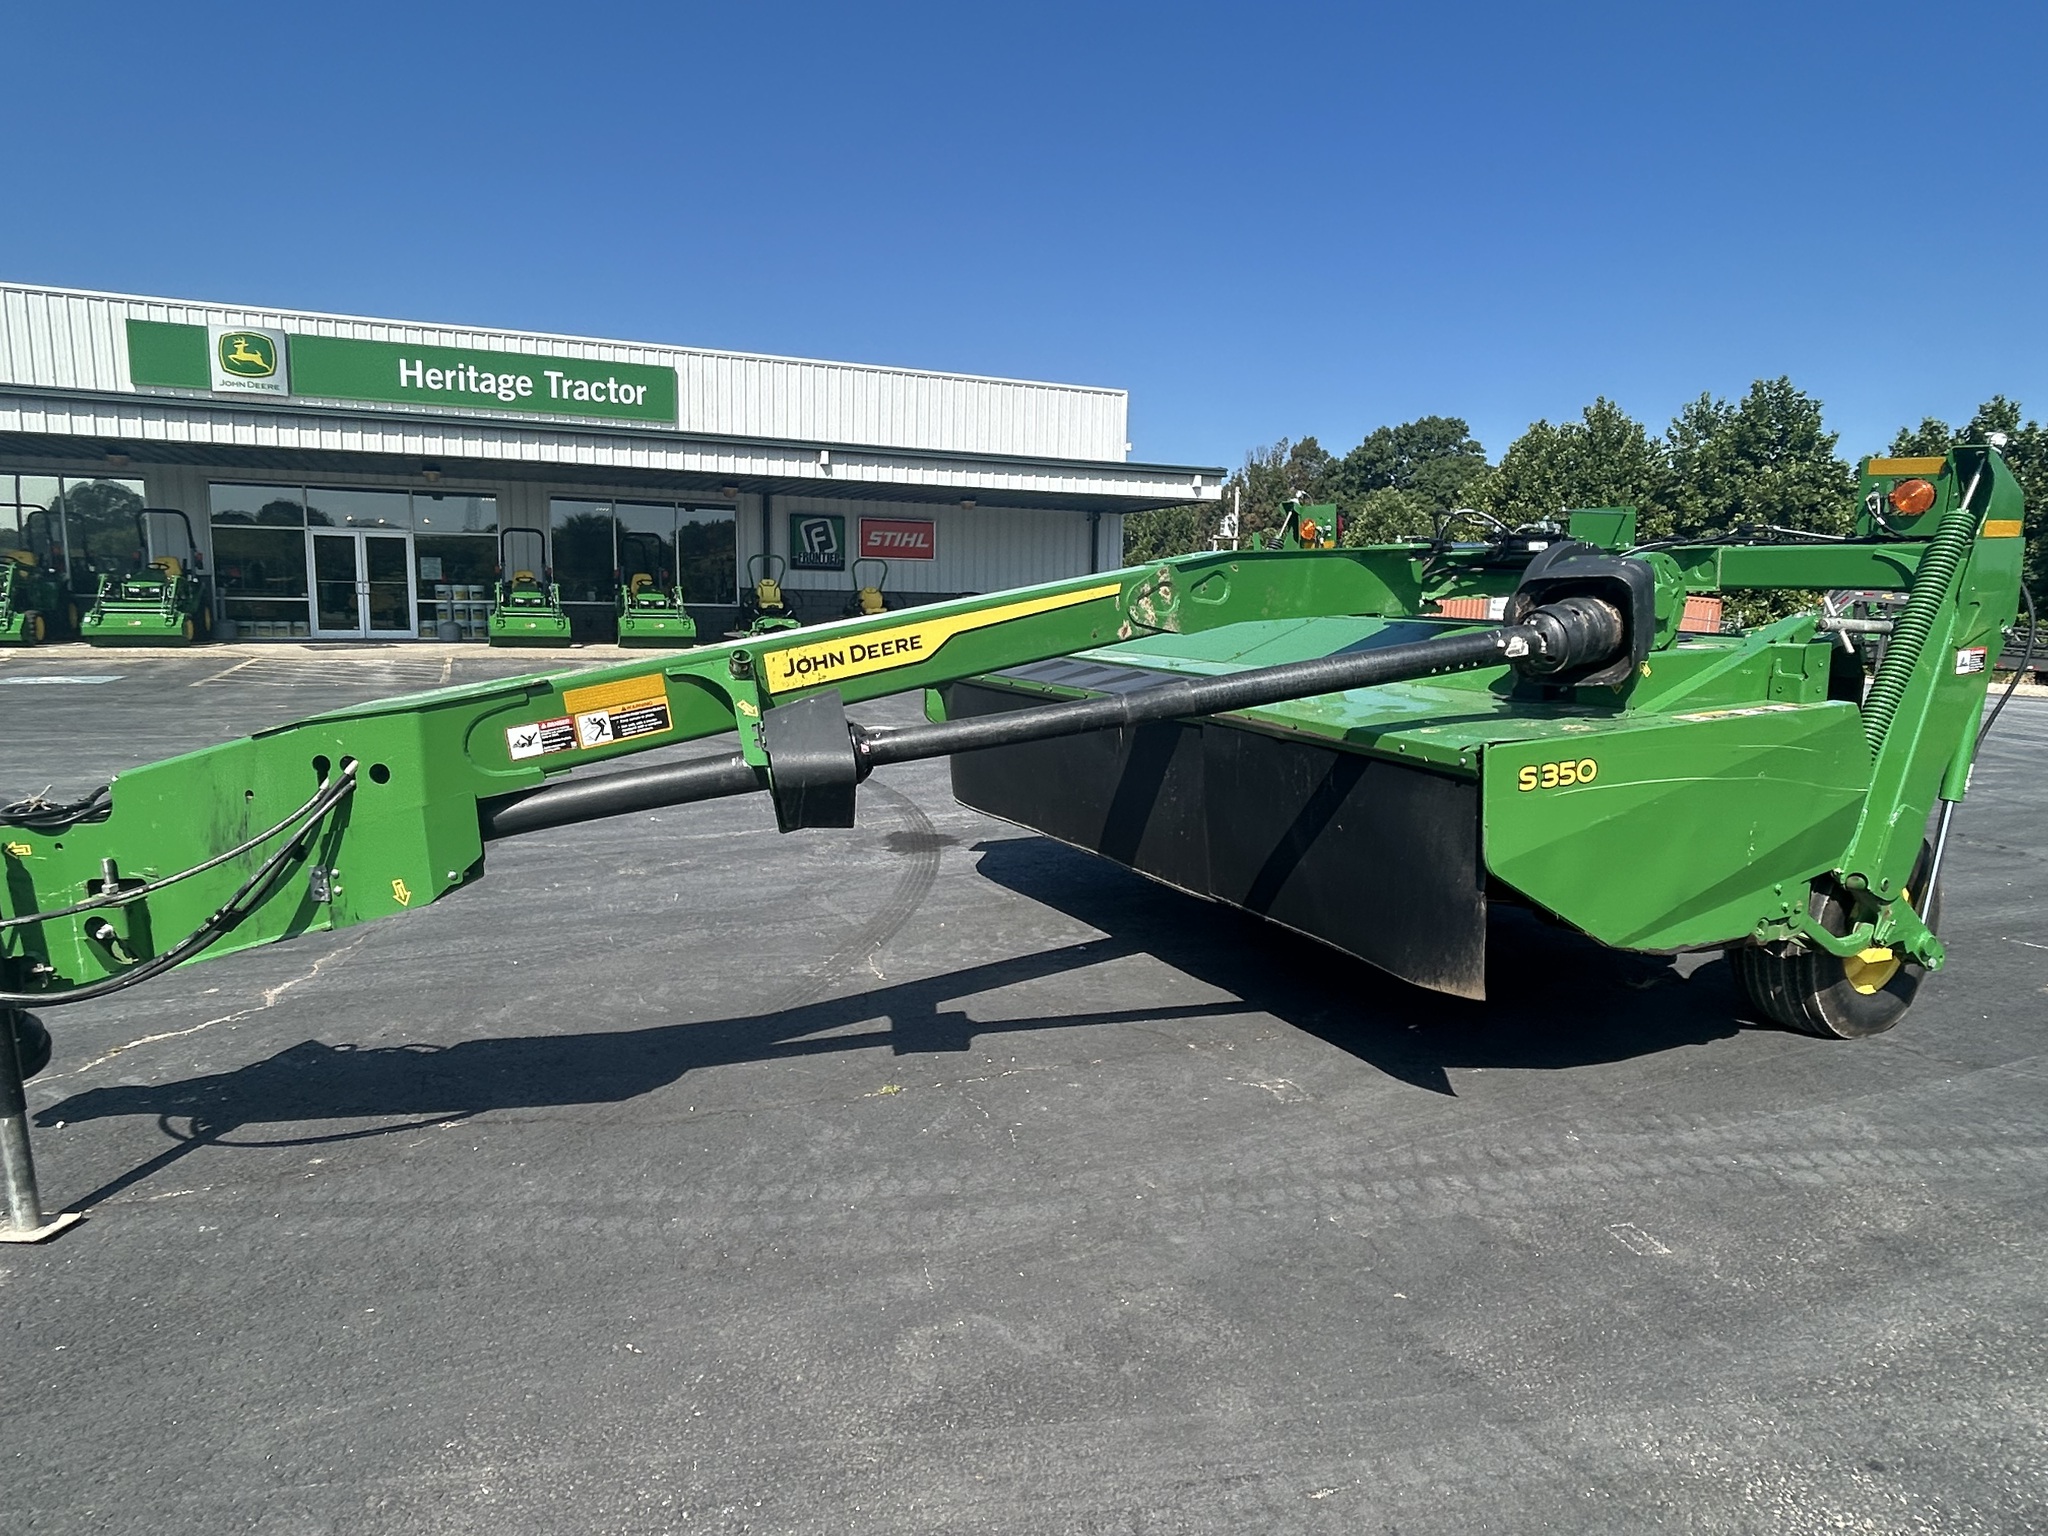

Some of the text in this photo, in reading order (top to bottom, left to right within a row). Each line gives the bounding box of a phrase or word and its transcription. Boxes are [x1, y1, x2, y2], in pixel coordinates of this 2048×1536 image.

[219, 379, 280, 391] JOHN DEERE
[399, 358, 648, 406] Heritage Tractor
[867, 531, 930, 548] STIHL
[798, 551, 841, 565] FRONTIER
[783, 635, 923, 679] JOHN DEERE
[1518, 757, 1599, 792] S350
